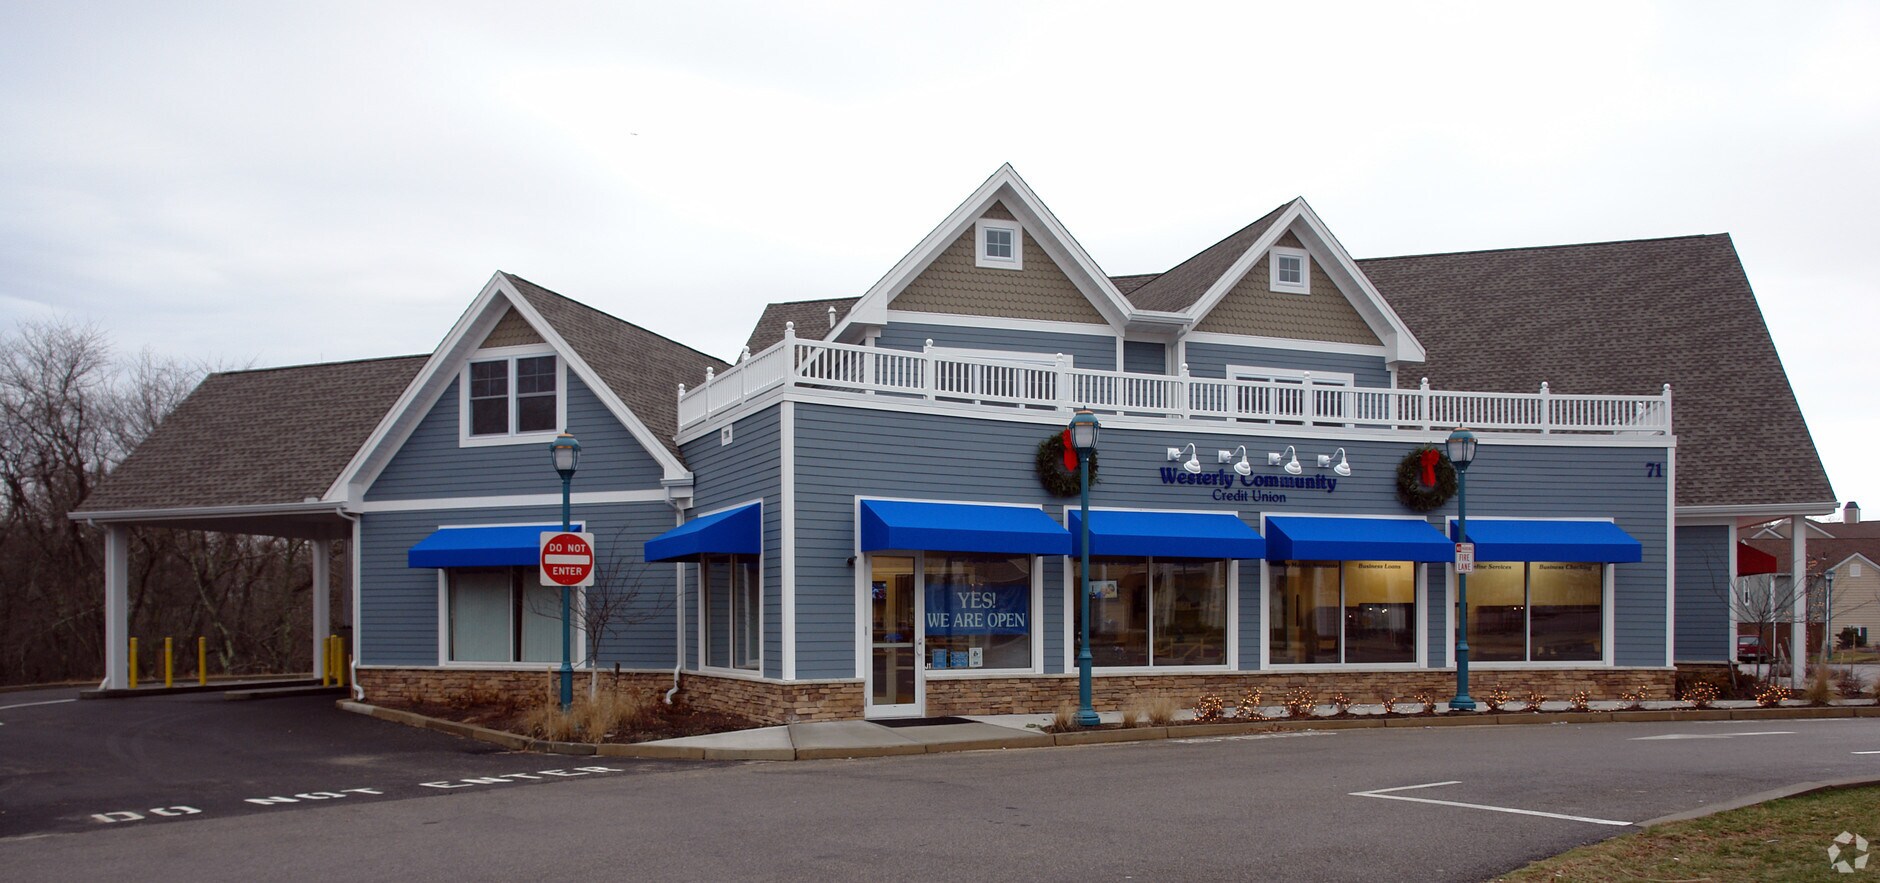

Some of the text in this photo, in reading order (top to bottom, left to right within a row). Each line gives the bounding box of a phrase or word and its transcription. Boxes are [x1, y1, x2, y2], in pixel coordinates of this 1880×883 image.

[1645, 462, 1662, 477] 71
[1160, 467, 1337, 493] Westerly Community
[1212, 489, 1286, 503] Credit Union
[549, 543, 586, 553] DO NOT
[1458, 553, 1470, 561] FIRE
[552, 566, 582, 576] ENTER
[1457, 562, 1471, 570] LANE
[957, 591, 996, 609] YES!
[927, 612, 1025, 628] WE ARE OPEN
[91, 766, 625, 823] DO NOT ENTER
